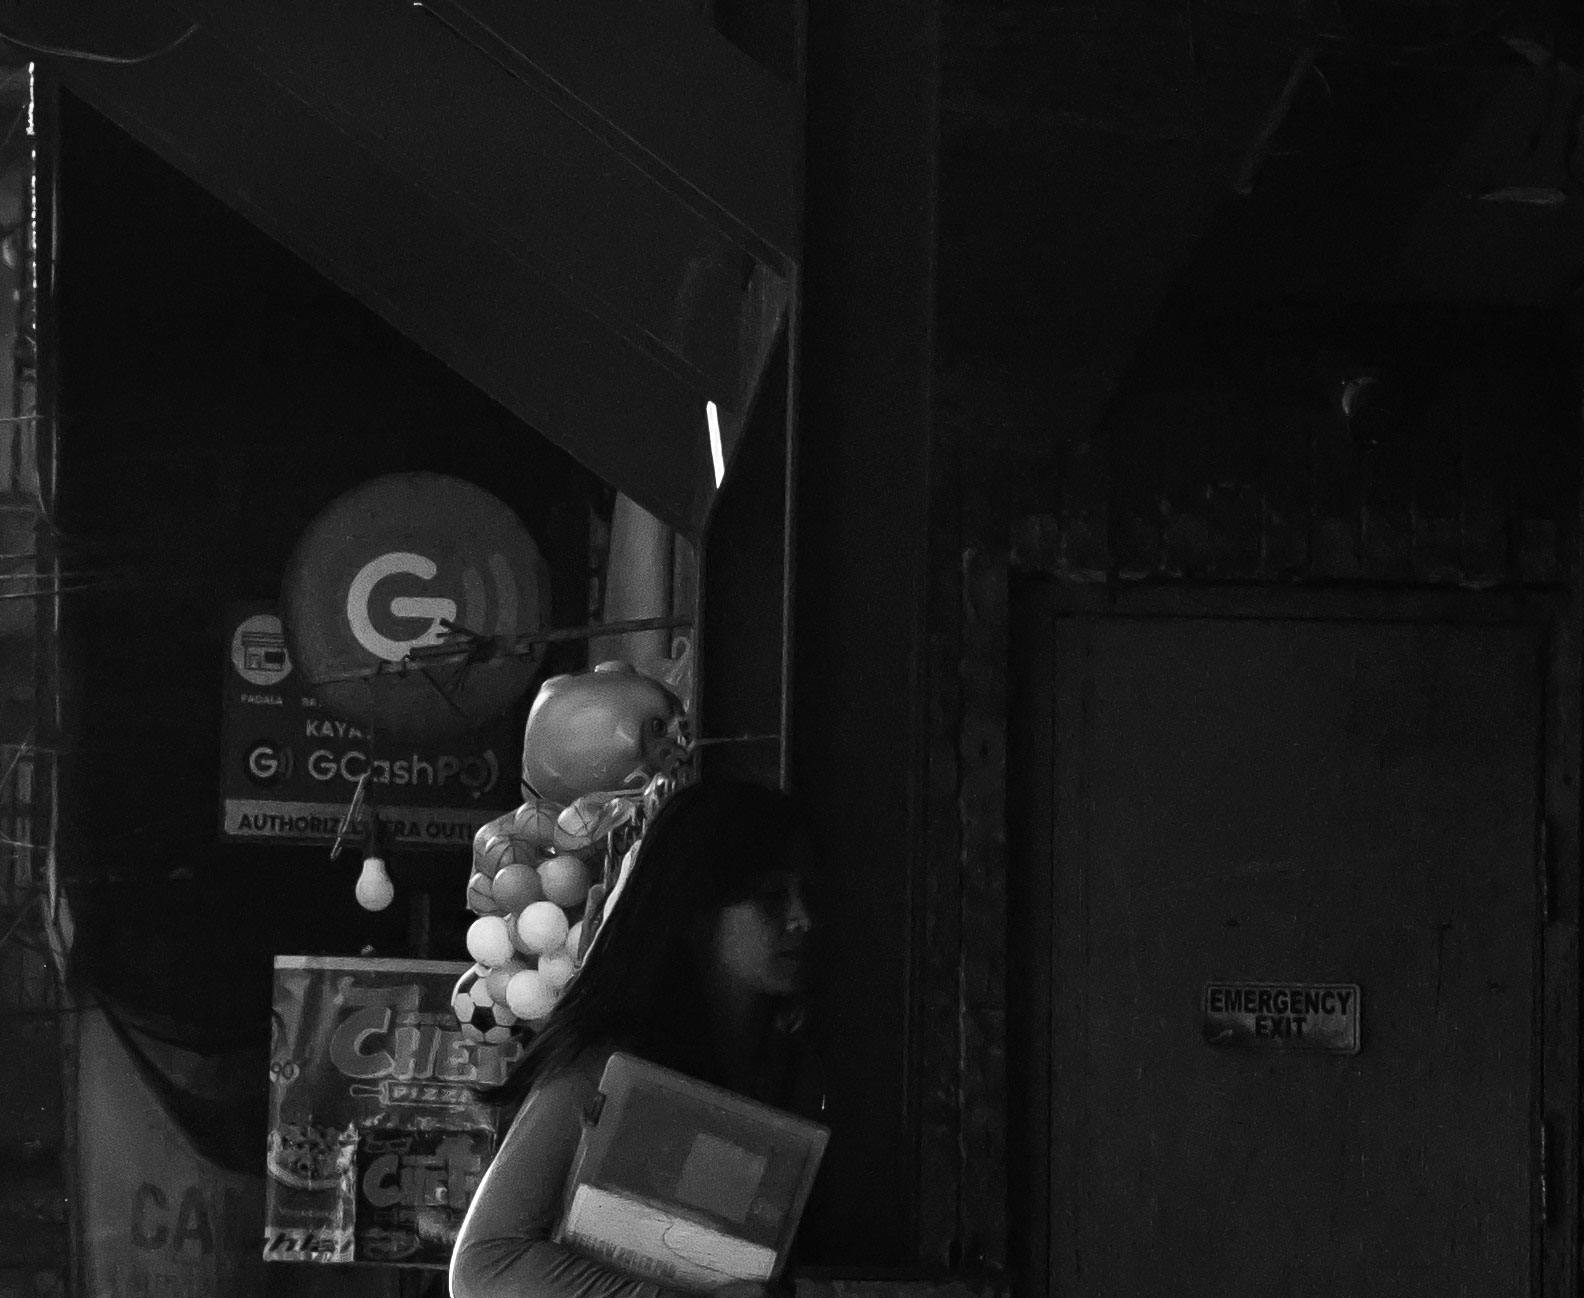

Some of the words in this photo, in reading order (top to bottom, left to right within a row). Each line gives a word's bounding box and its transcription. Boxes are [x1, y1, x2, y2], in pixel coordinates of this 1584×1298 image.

[346, 551, 457, 662] G
[238, 813, 365, 836] AUTHORIZ
[1209, 988, 1352, 1016] EMERGENCY
[1255, 1015, 1307, 1038] EXIT
